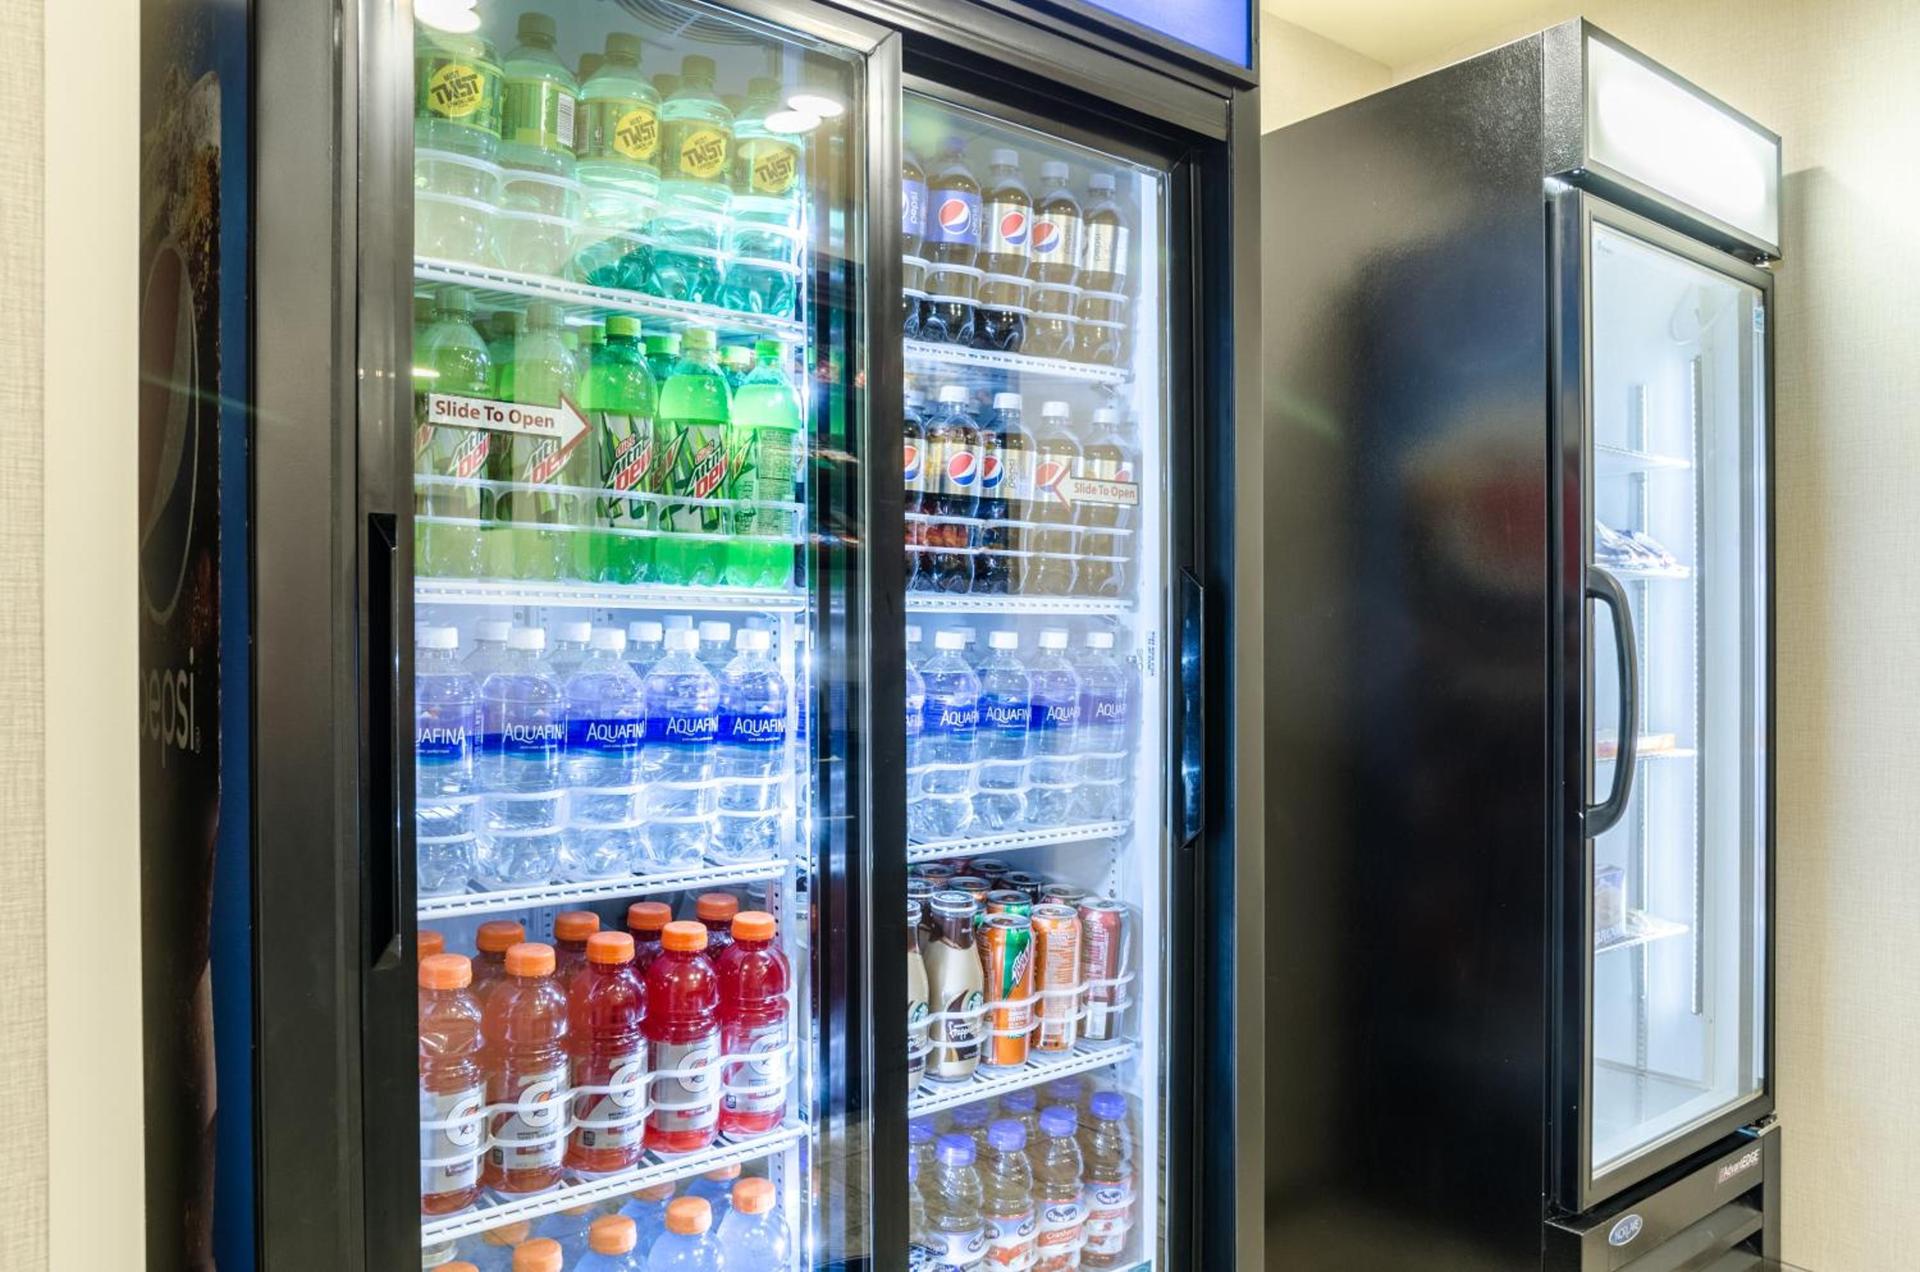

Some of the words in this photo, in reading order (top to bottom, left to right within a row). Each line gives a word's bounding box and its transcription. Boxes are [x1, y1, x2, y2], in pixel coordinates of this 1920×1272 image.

[435, 400, 481, 420] Slide
[484, 406, 504, 422] To
[508, 409, 555, 428] Open
[1074, 481, 1097, 495] Slide
[1110, 486, 1136, 499] Open
[503, 723, 563, 743] AQUAFIN
[586, 720, 645, 742] AQUAFIN
[666, 715, 720, 736] AQUAFIN
[733, 717, 785, 736] AQUAFIN
